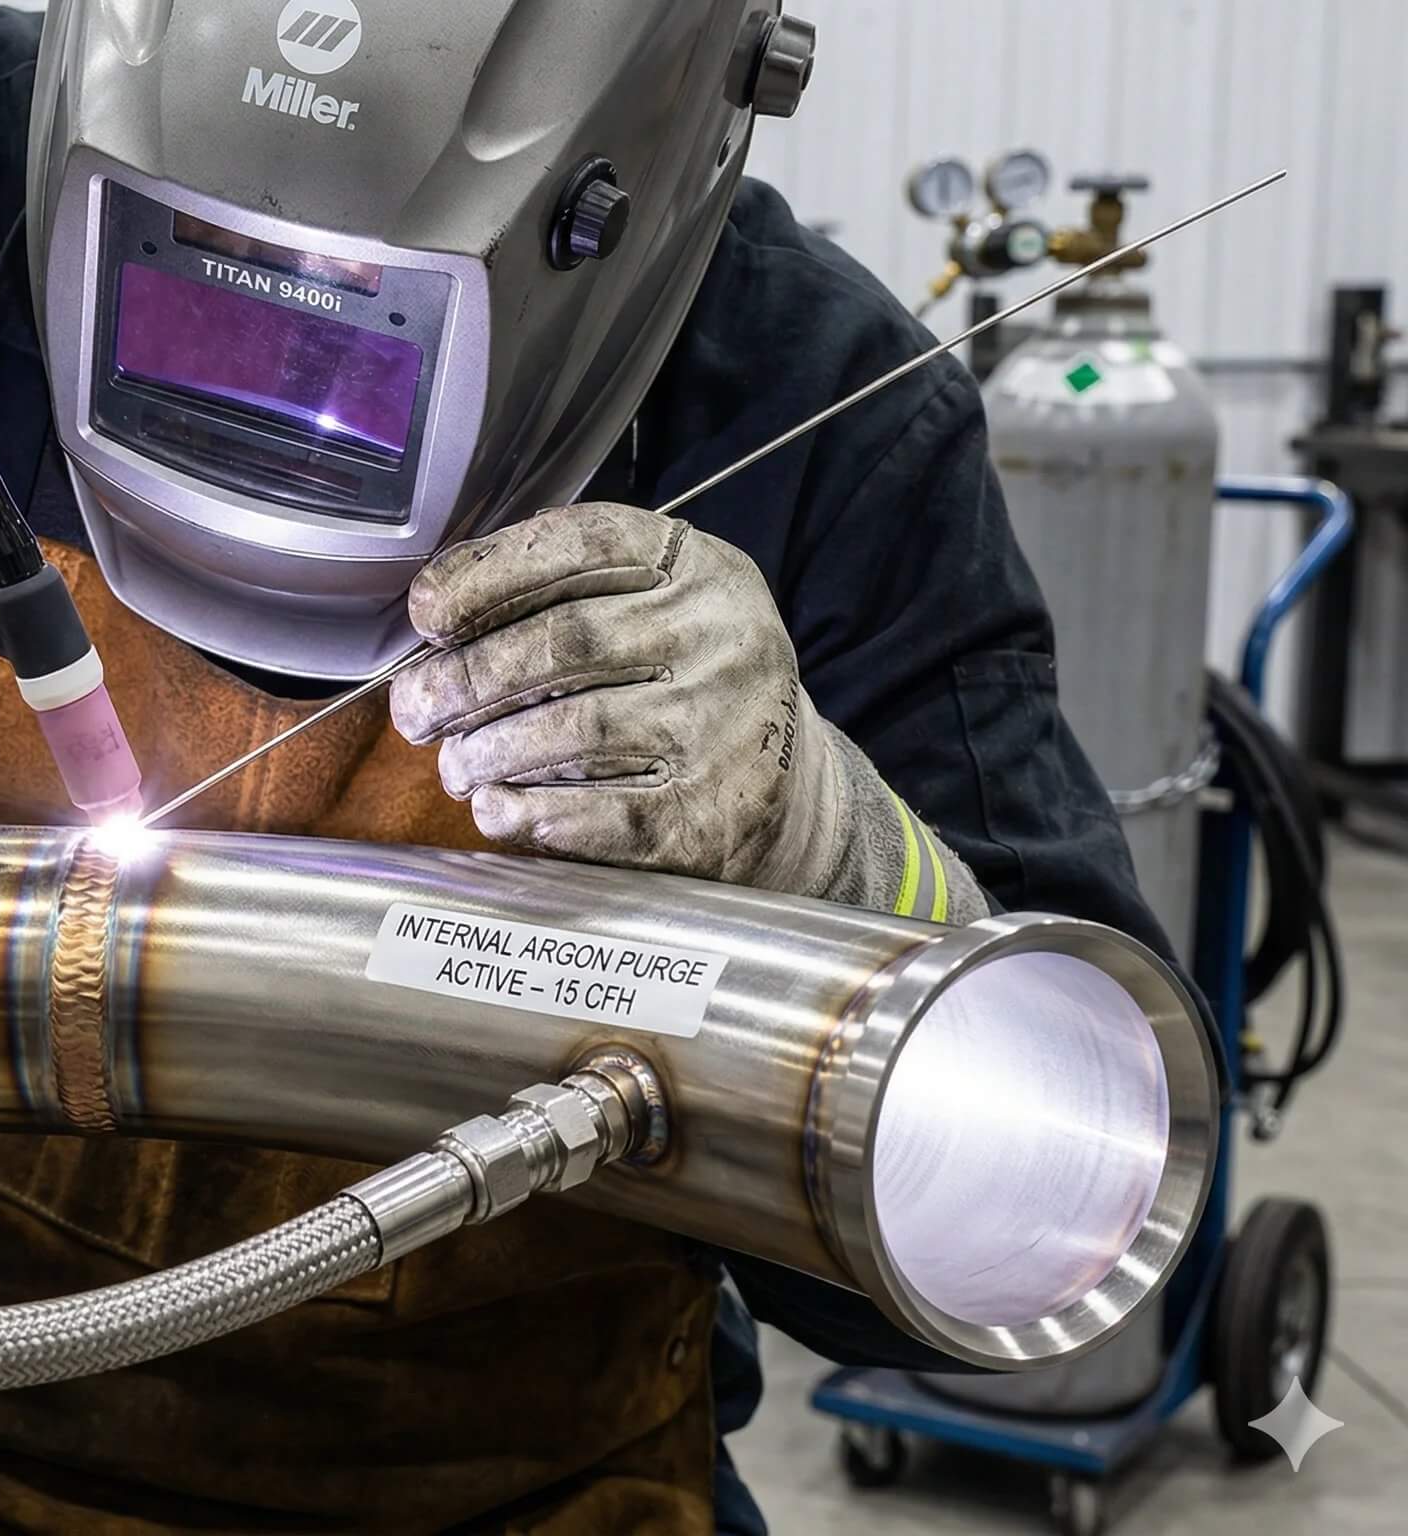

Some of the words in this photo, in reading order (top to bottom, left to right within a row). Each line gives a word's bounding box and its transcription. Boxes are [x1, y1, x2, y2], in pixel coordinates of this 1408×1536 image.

[201, 258, 272, 293] TITAN
[279, 281, 343, 313] 9400i
[395, 913, 513, 957] INTERNAL
[518, 935, 614, 972] ARGON
[614, 950, 708, 987] PURGE
[435, 956, 528, 997] ACTIVE
[554, 977, 581, 1006] 15
[584, 982, 637, 1016] CFH
